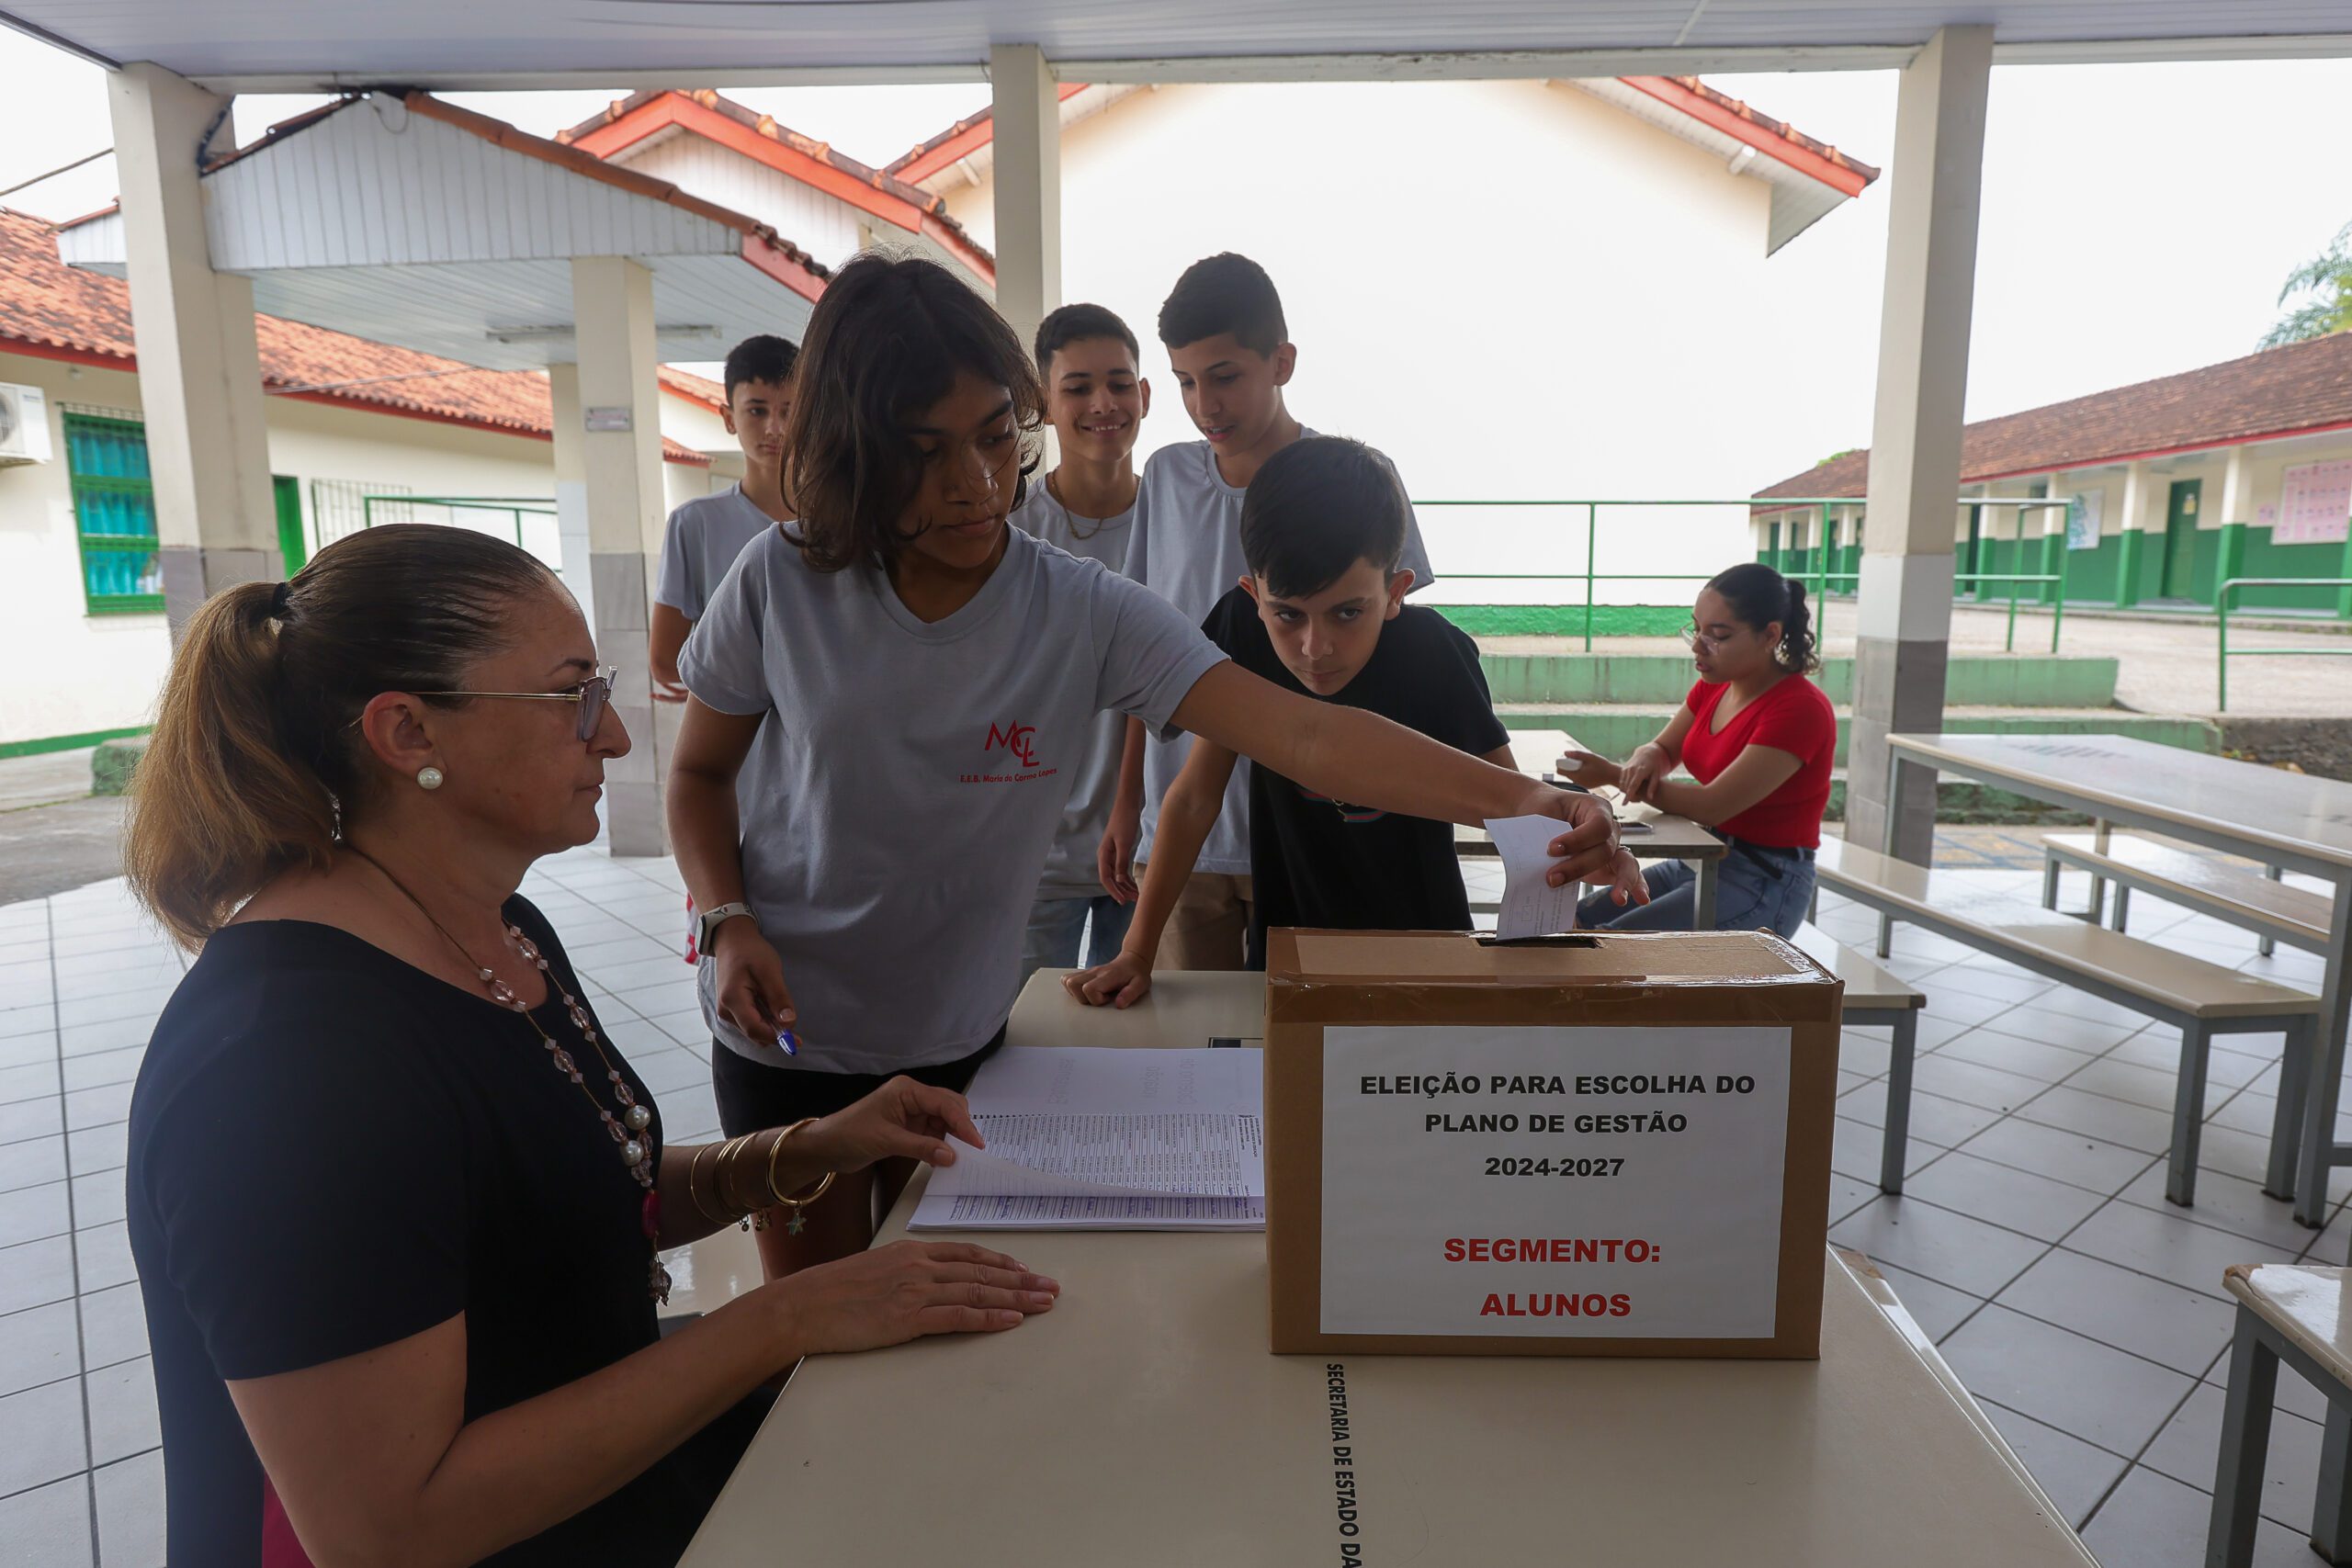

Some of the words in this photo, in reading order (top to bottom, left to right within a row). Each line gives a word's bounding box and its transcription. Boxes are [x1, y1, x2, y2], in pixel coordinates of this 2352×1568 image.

[983, 773, 1002, 783] Maria
[1361, 1071, 1481, 1100] ELEIÇÃO
[1490, 1075, 1566, 1095] PARA
[1575, 1075, 1707, 1095] ESCOLHA
[1715, 1075, 1756, 1094] DO
[1425, 1113, 1520, 1134] PLANO
[1529, 1114, 1566, 1134] DE
[1574, 1110, 1688, 1134] GESTÃO
[1484, 1156, 1625, 1178] 2024-2027
[1443, 1237, 1661, 1264] SEGMENTO:
[1479, 1292, 1633, 1317] ALUNOS
[1327, 1363, 1350, 1441] SECRETARIA
[1333, 1446, 1352, 1466] DE
[1335, 1471, 1360, 1537] ESTADO
[1340, 1543, 1363, 1568] DA
